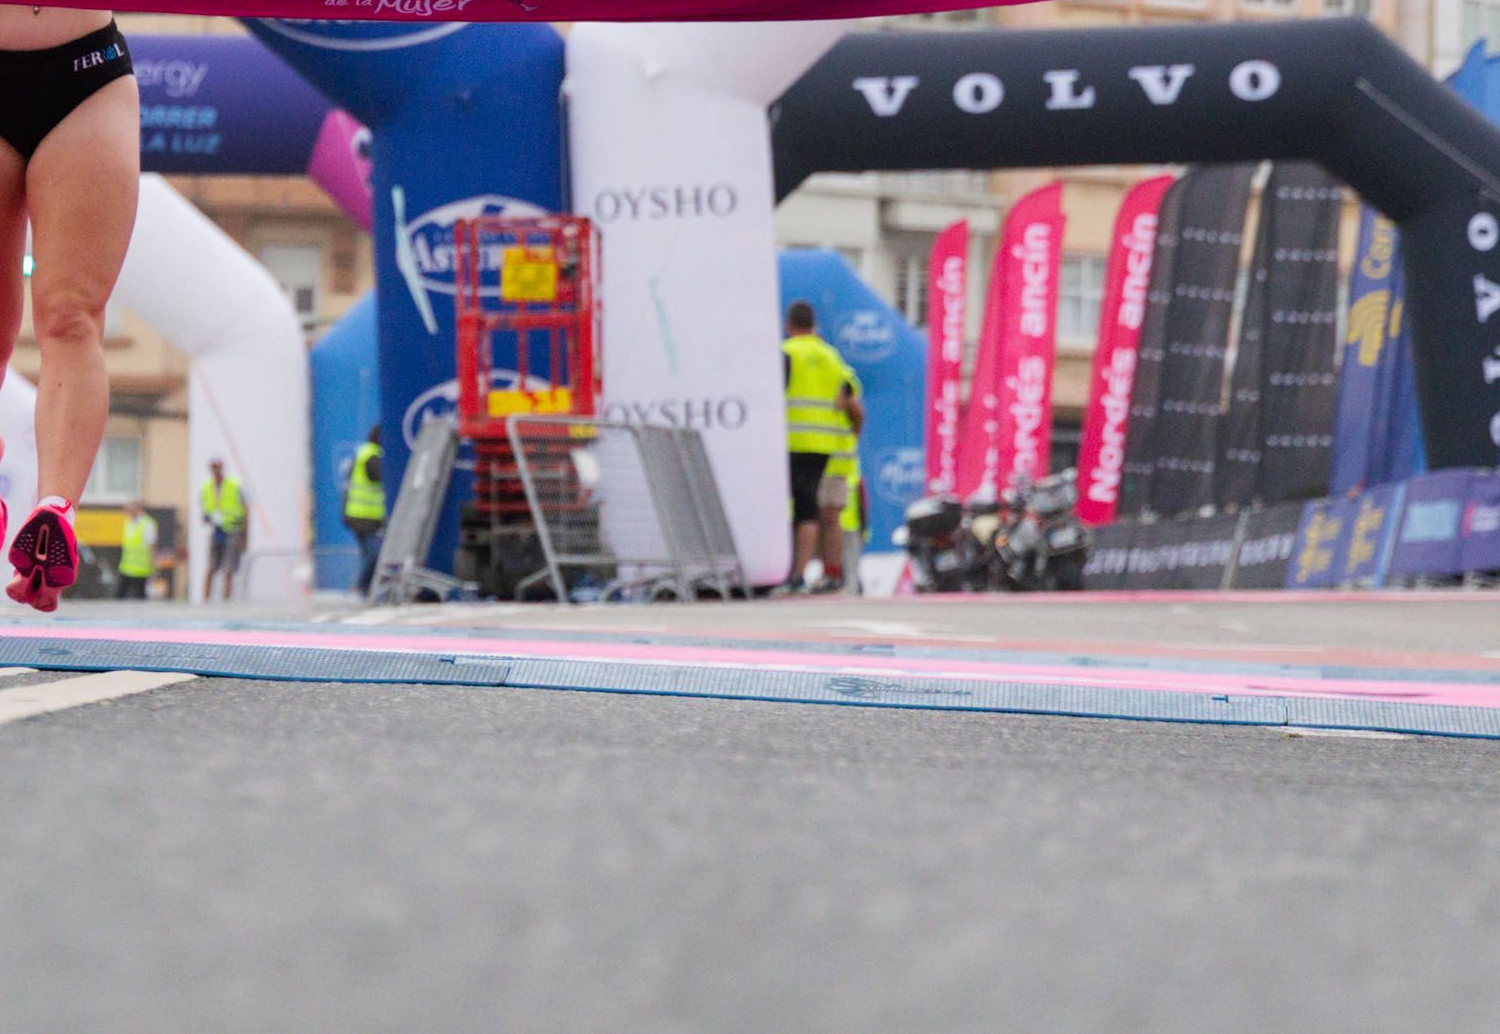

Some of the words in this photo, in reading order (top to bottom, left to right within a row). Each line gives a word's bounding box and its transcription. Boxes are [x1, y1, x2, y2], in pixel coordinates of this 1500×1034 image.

[853, 60, 1281, 117] VOLVO
[594, 181, 739, 224] OYSHO
[604, 394, 749, 432] OYSHO
